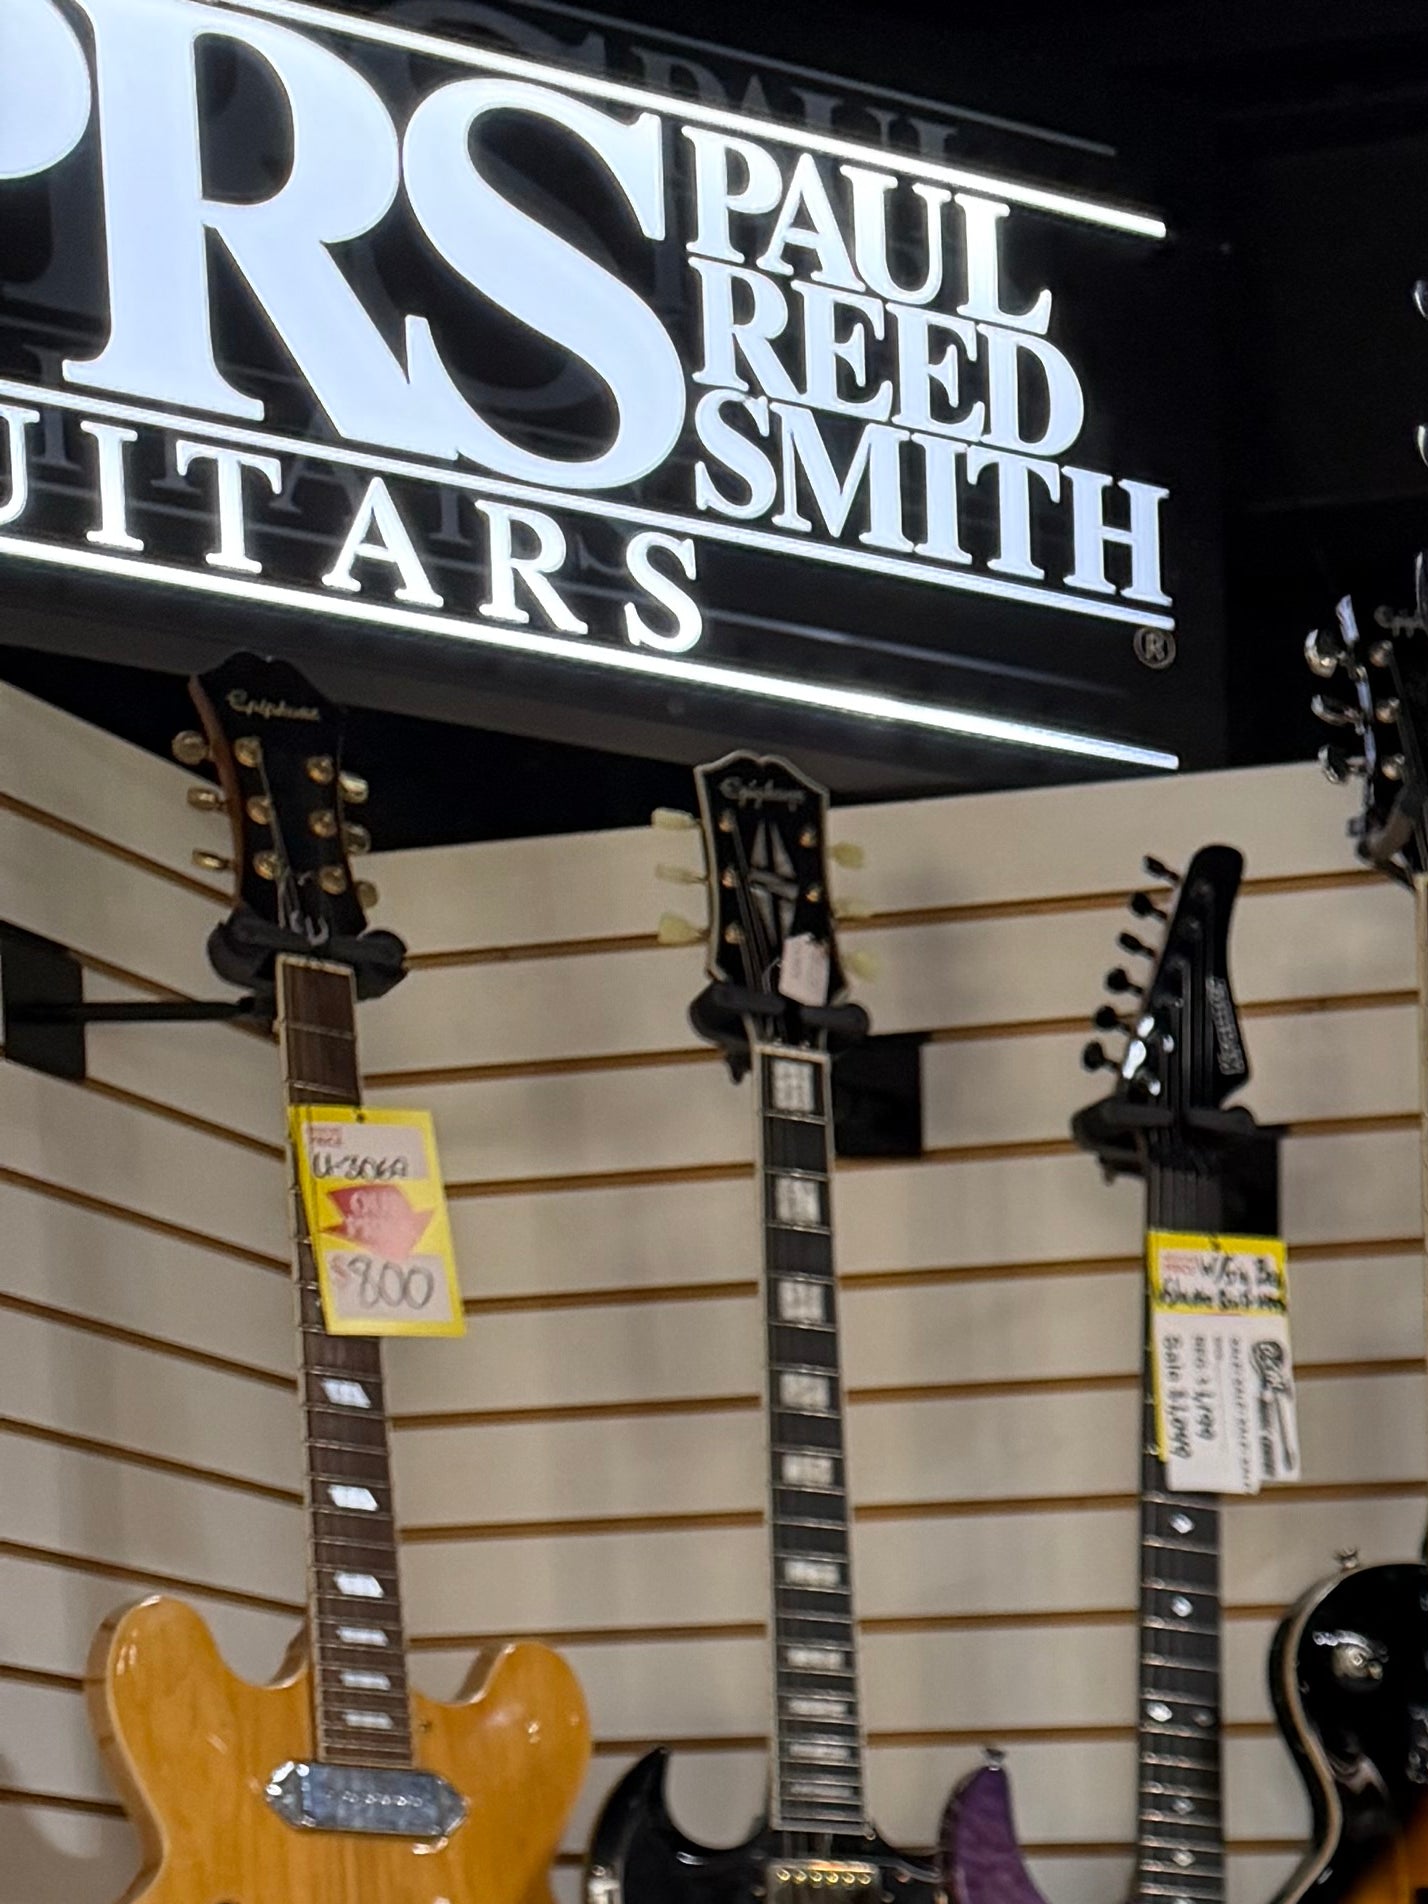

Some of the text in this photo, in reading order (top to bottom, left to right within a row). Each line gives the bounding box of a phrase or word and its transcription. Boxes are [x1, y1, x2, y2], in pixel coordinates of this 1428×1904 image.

[682, 125, 1053, 335] PAUL
[688, 256, 1085, 457] REED
[695, 389, 1173, 607] SMITH
